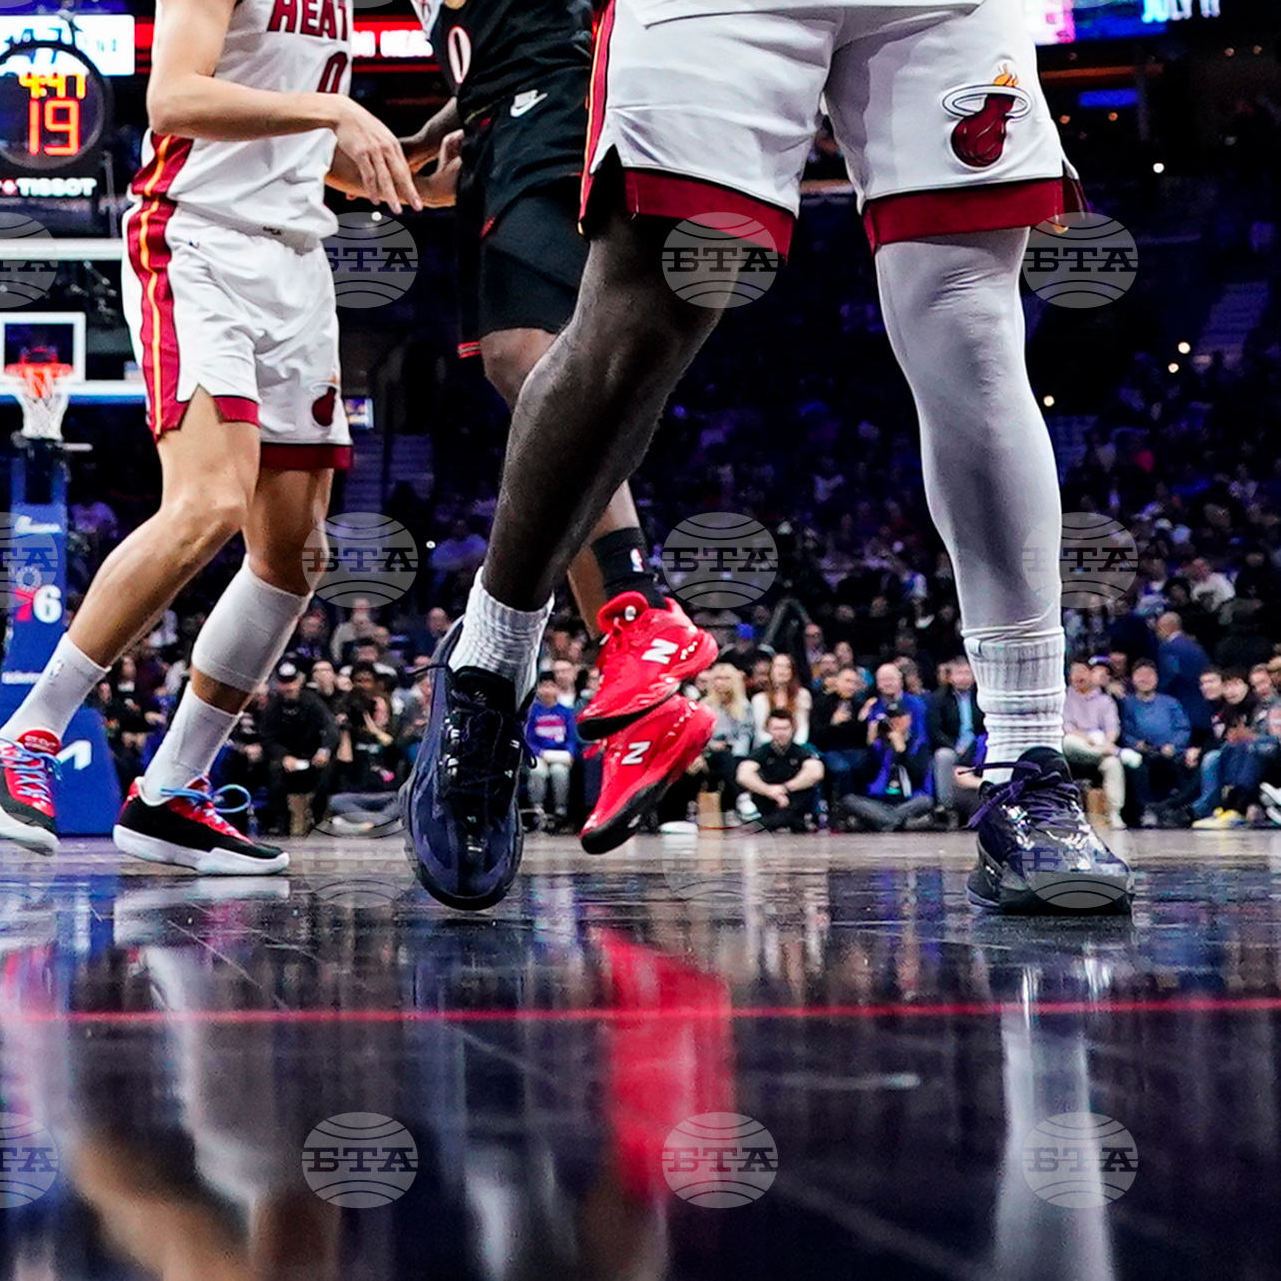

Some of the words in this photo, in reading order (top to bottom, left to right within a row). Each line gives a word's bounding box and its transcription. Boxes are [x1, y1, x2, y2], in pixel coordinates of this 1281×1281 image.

[447, 25, 472, 85] 0
[18, 72, 87, 100] 4:47
[28, 96, 81, 156] 19
